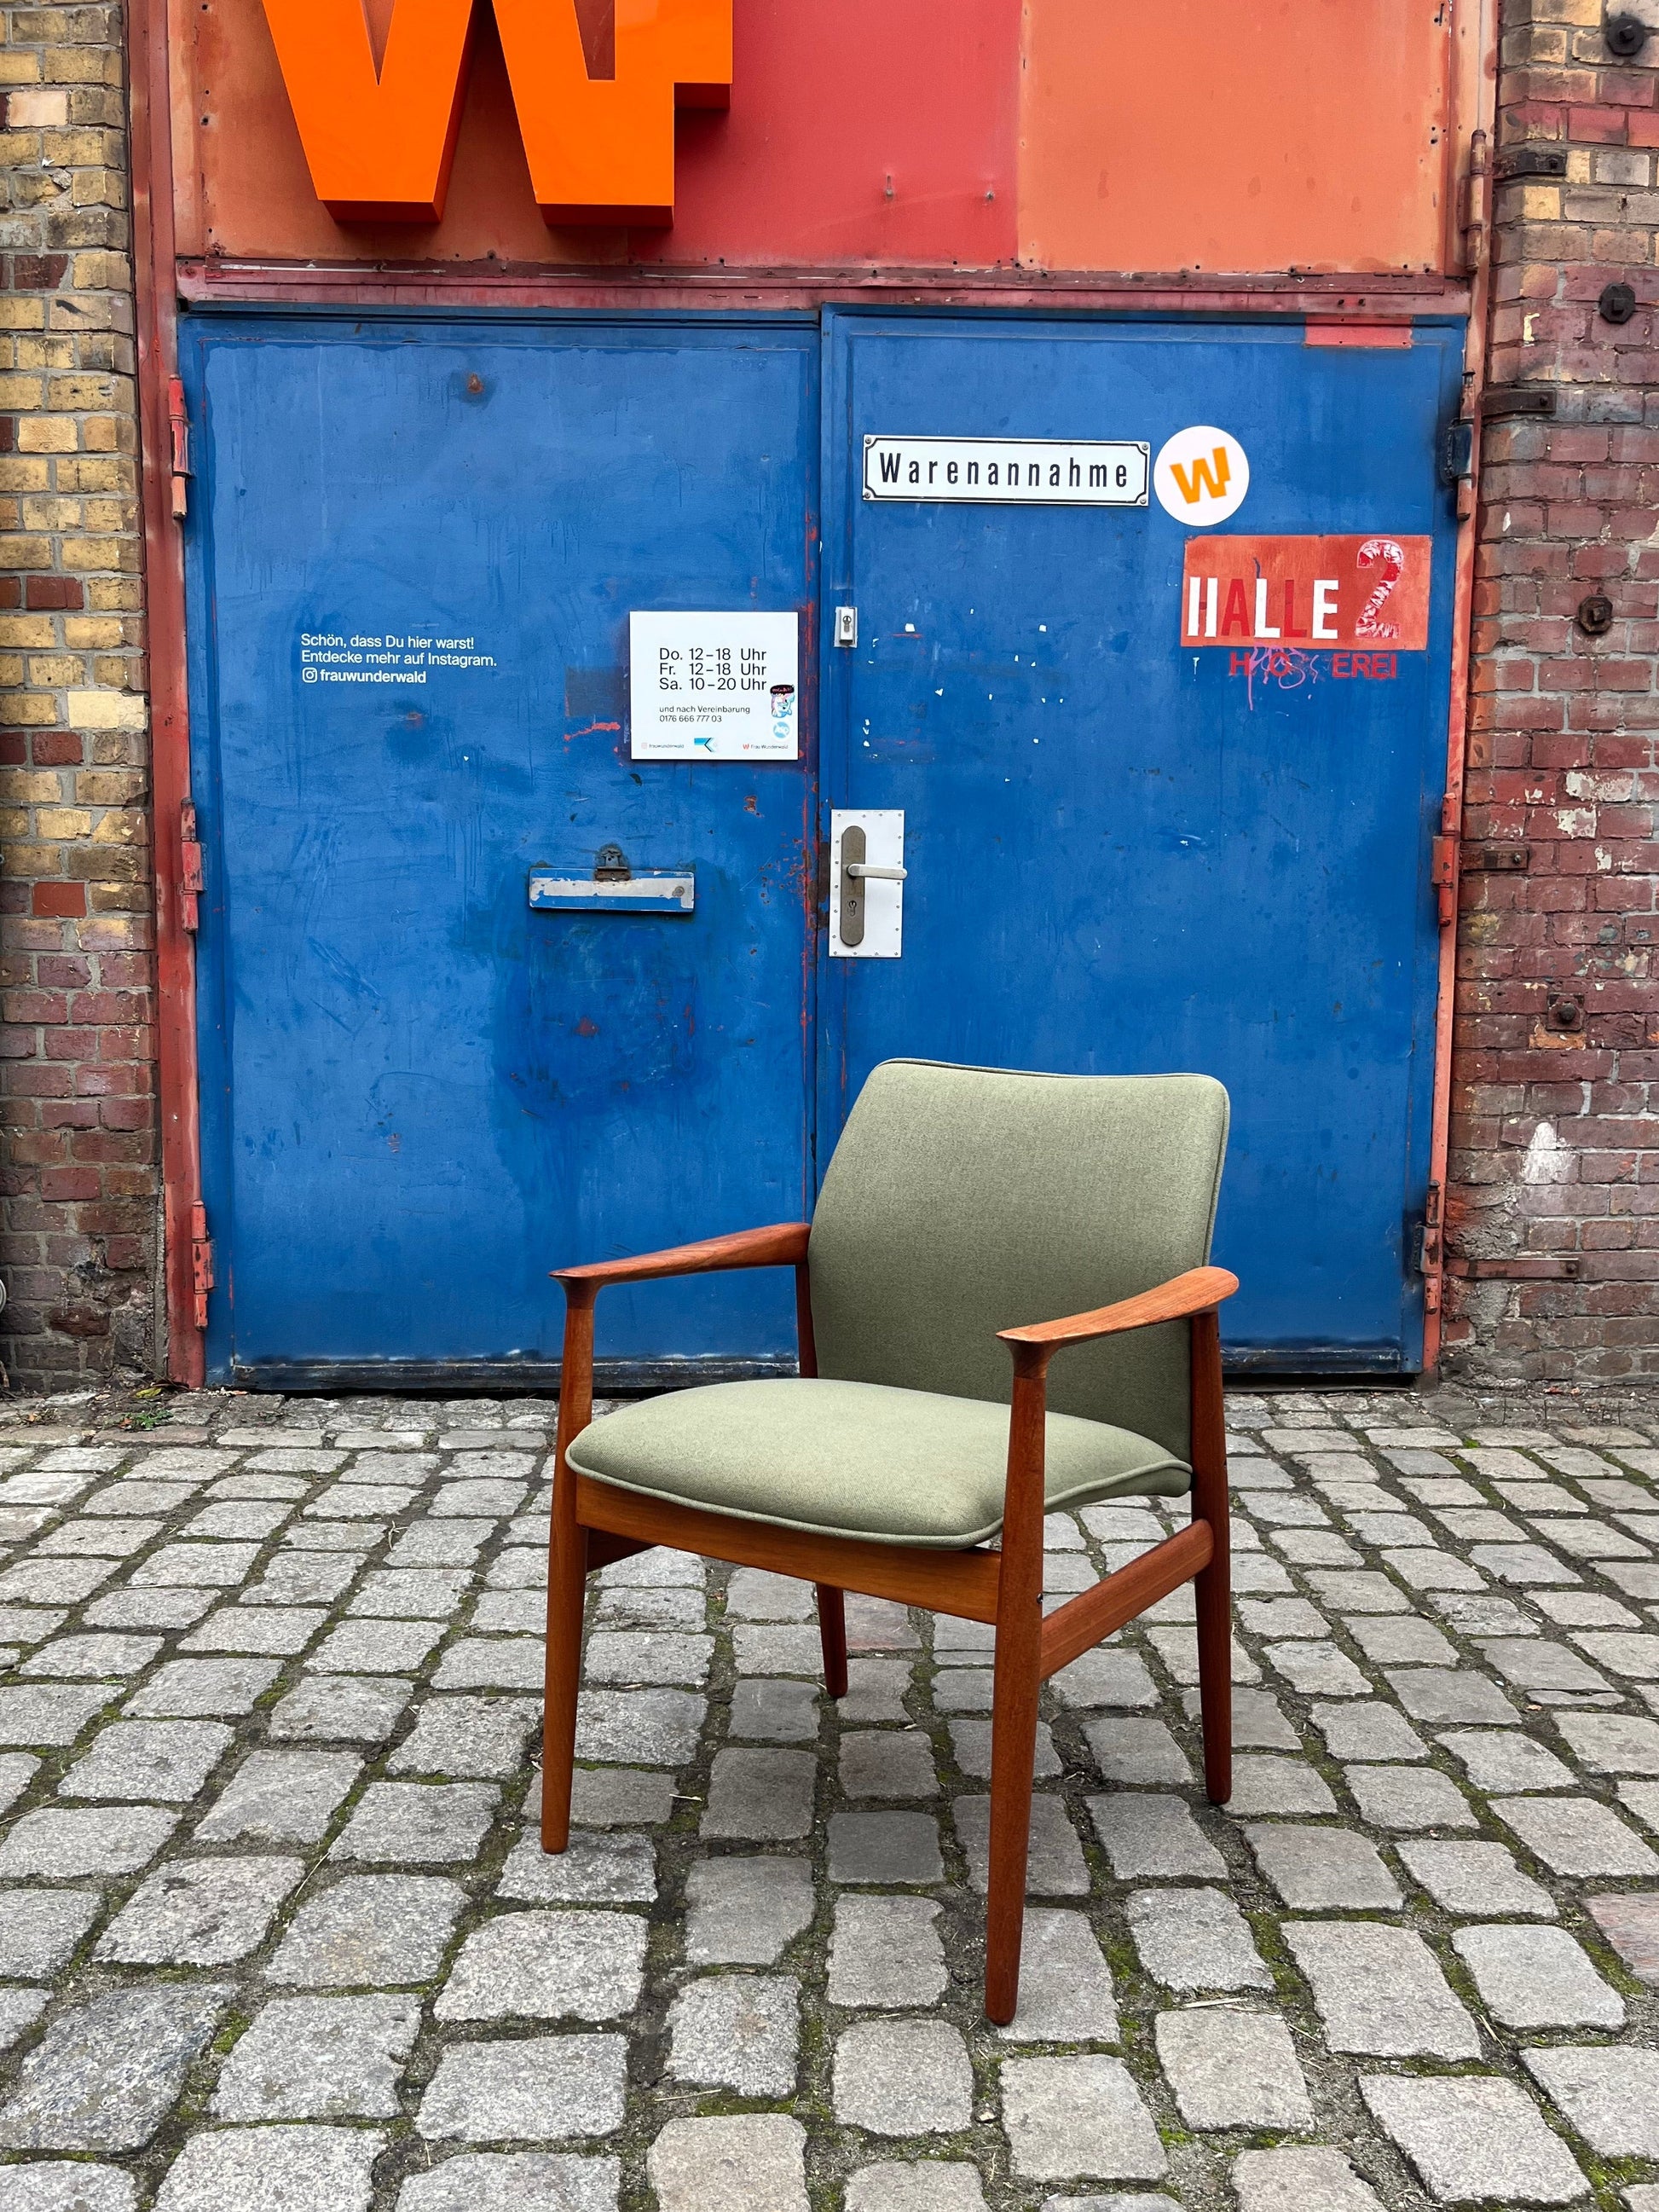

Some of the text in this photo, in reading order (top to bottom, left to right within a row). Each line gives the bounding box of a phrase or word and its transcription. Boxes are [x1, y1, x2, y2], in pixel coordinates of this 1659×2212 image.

[879, 452, 1128, 489] Warenannahme
[1186, 539, 1405, 640] HALLE 2
[301, 633, 475, 650] Schön, dass Du hier warst!
[301, 650, 497, 669] Entdecke mehr auf Instagram.
[659, 648, 683, 661] Do.
[740, 648, 767, 661] Uhr
[320, 669, 427, 684] frauwunderwald
[659, 663, 676, 675] Fr.
[740, 663, 767, 675] Uhr
[659, 677, 682, 691] Sa.
[740, 678, 767, 691] Uhr
[698, 705, 750, 715] Vereinbarung
